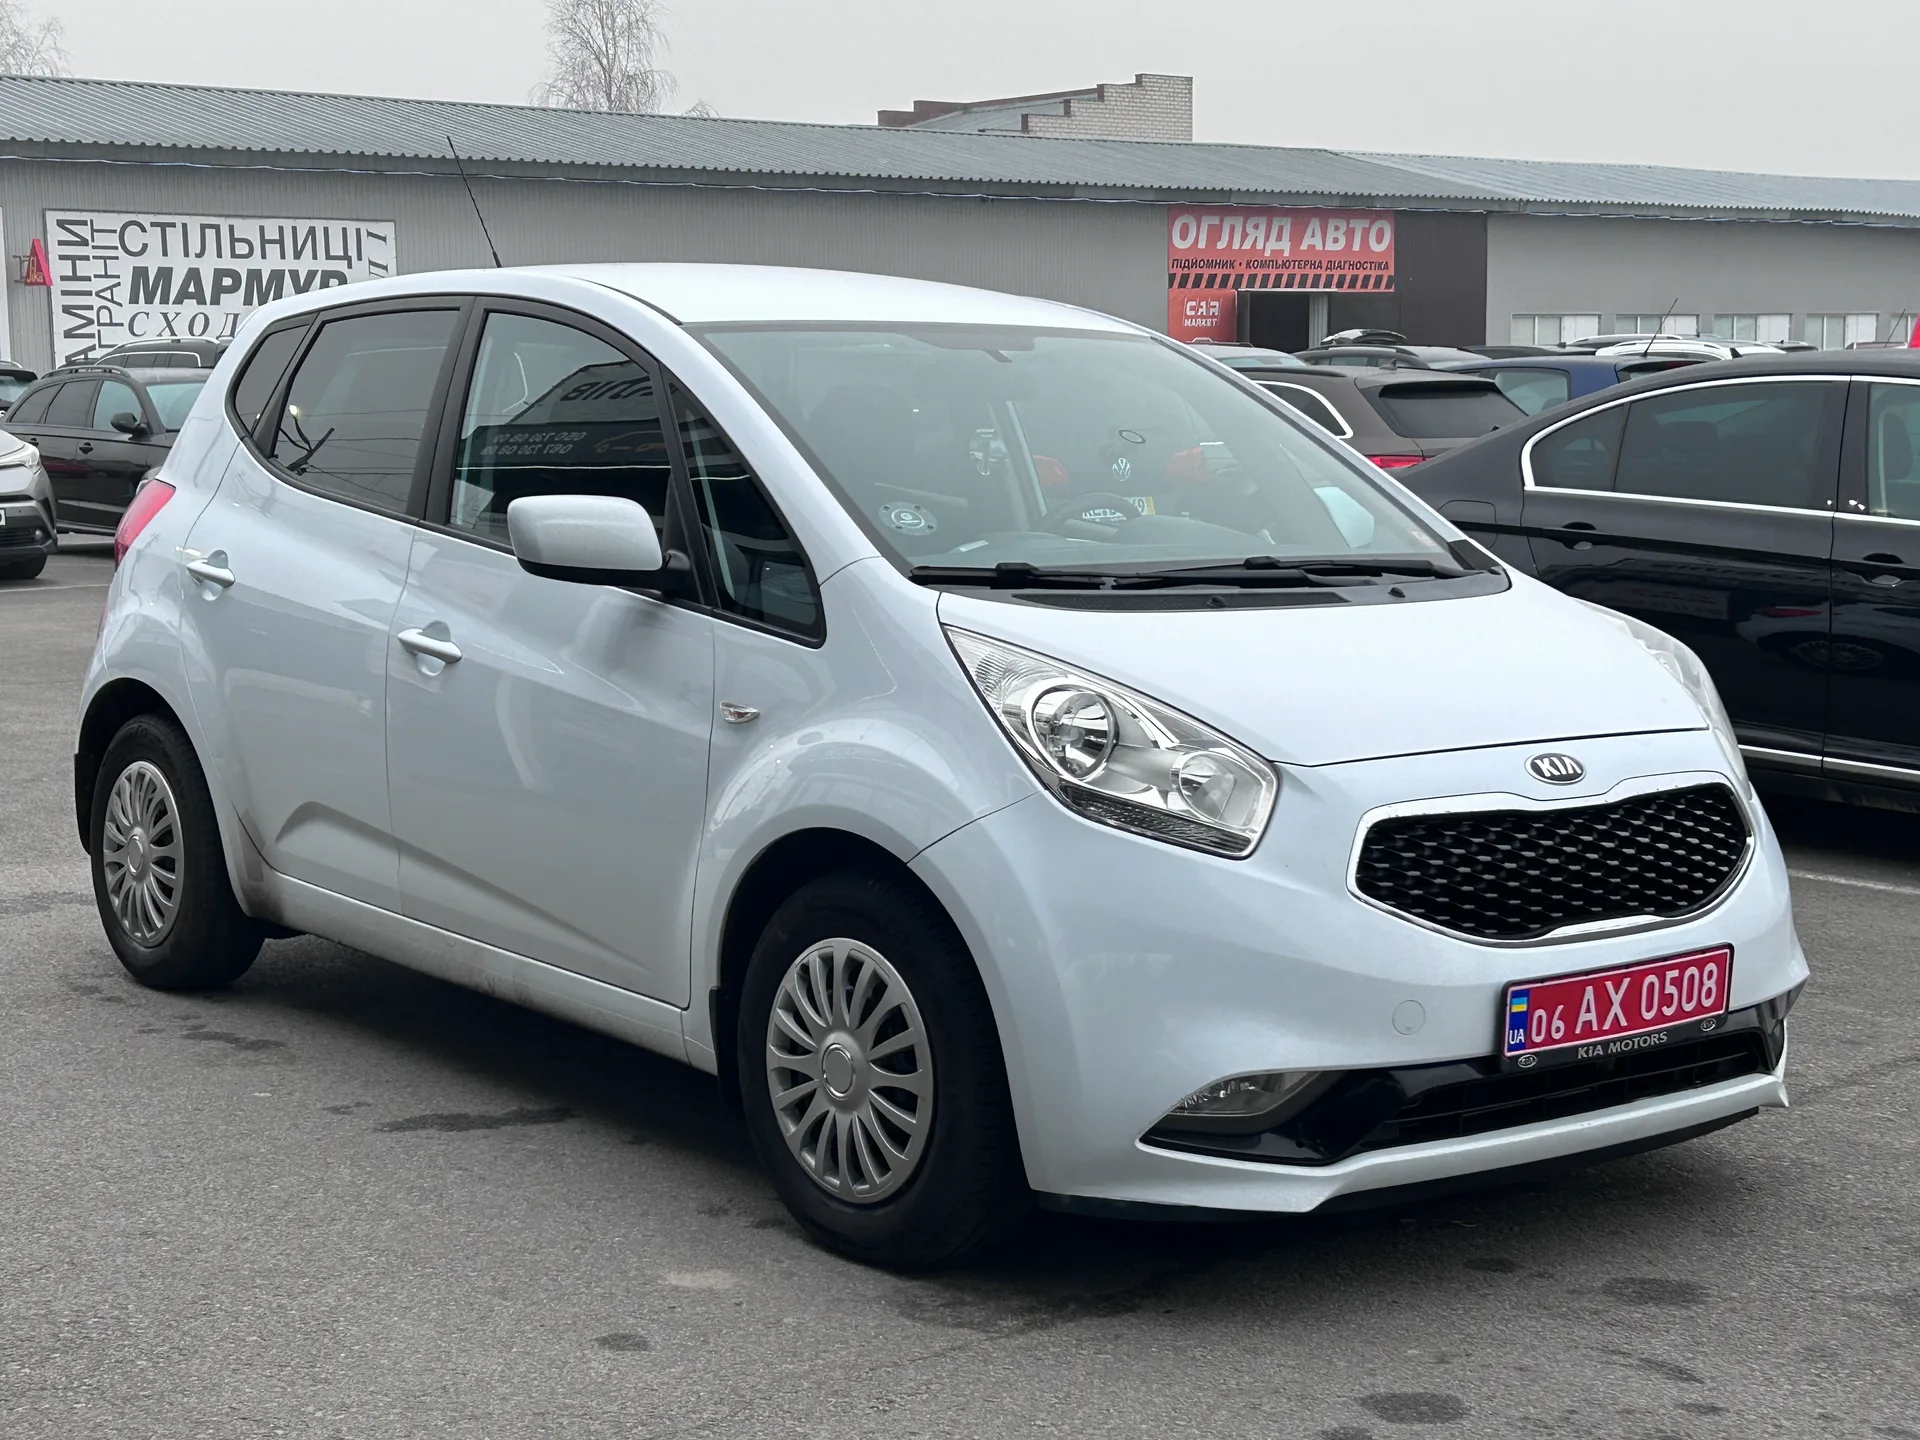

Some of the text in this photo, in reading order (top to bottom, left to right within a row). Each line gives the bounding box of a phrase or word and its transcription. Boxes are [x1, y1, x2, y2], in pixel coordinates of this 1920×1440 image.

[118, 220, 363, 269] СТІЛЬНИЦІ
[1171, 215, 1392, 257] ОГЛЯД АВТО
[1171, 256, 1236, 271] ПІДЙОМНИК
[1245, 258, 1323, 271] КОМПЬЮТЕРНА
[55, 218, 98, 366] АМІНИ
[90, 219, 125, 351] ГРАНІТ
[127, 311, 242, 341] СХОД
[1185, 300, 1220, 316] CAR
[1530, 962, 1718, 1043] 06 AX 0508
[1509, 1028, 1525, 1045] UA
[1577, 1031, 1668, 1059] KIA MOTORS
